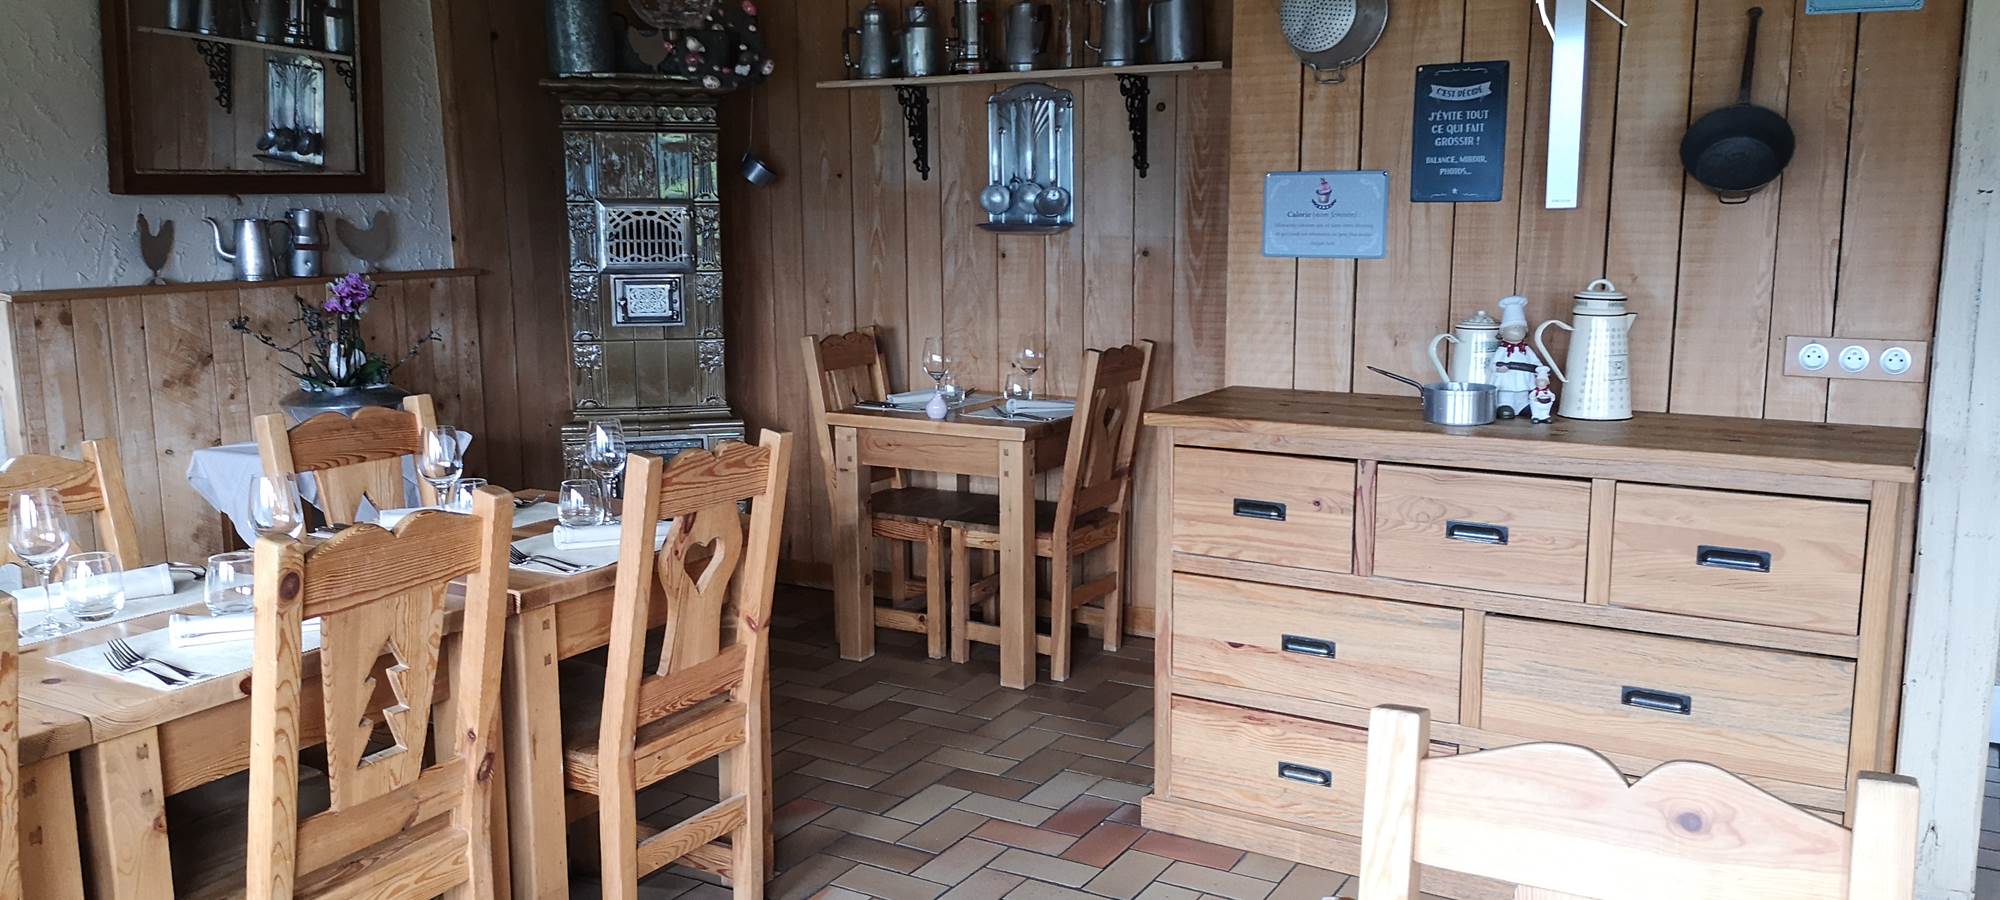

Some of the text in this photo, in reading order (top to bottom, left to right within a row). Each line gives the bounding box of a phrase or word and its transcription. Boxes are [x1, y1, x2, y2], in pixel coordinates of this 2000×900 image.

[1428, 110, 1489, 121] J'ÉVITE TOUT
[1431, 123, 1484, 135] CE QUI FAIT
[1435, 137, 1473, 146] GROSSIR
